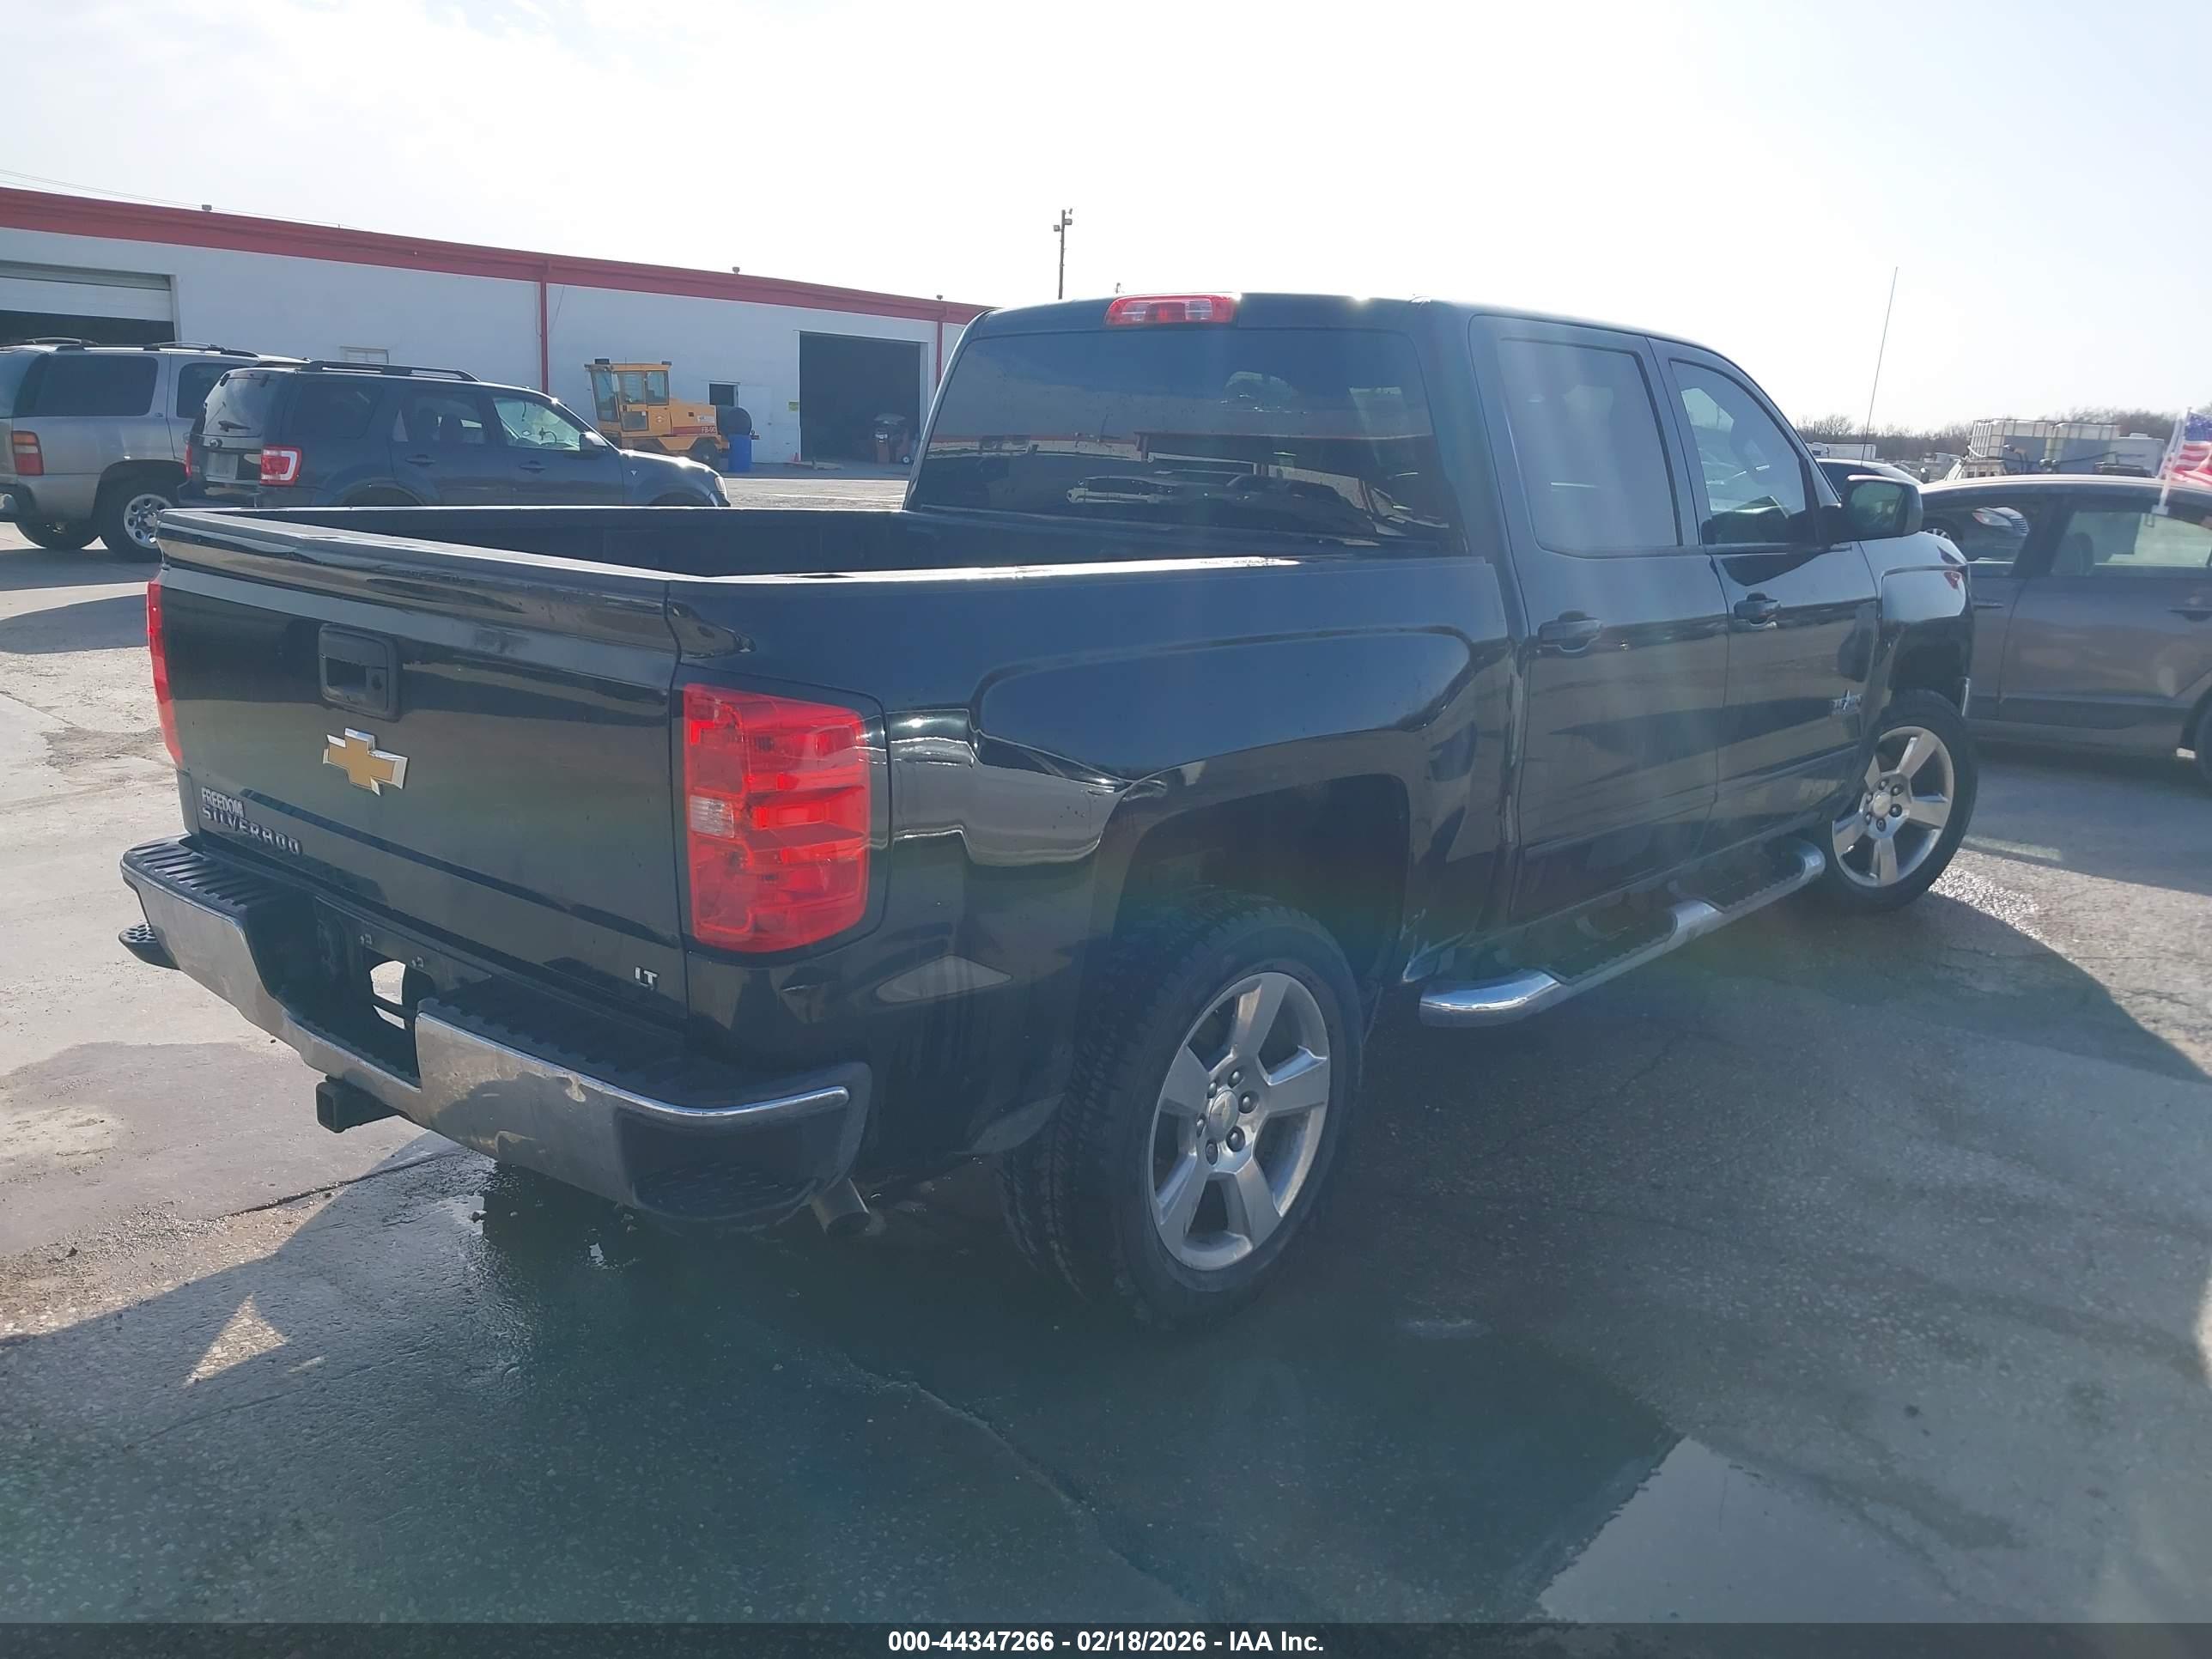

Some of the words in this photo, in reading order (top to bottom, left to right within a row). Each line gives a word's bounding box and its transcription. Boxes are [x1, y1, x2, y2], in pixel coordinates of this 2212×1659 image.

[202, 787, 245, 817] FREEDOM
[202, 807, 301, 856] SILVERADO
[635, 967, 658, 987] LT
